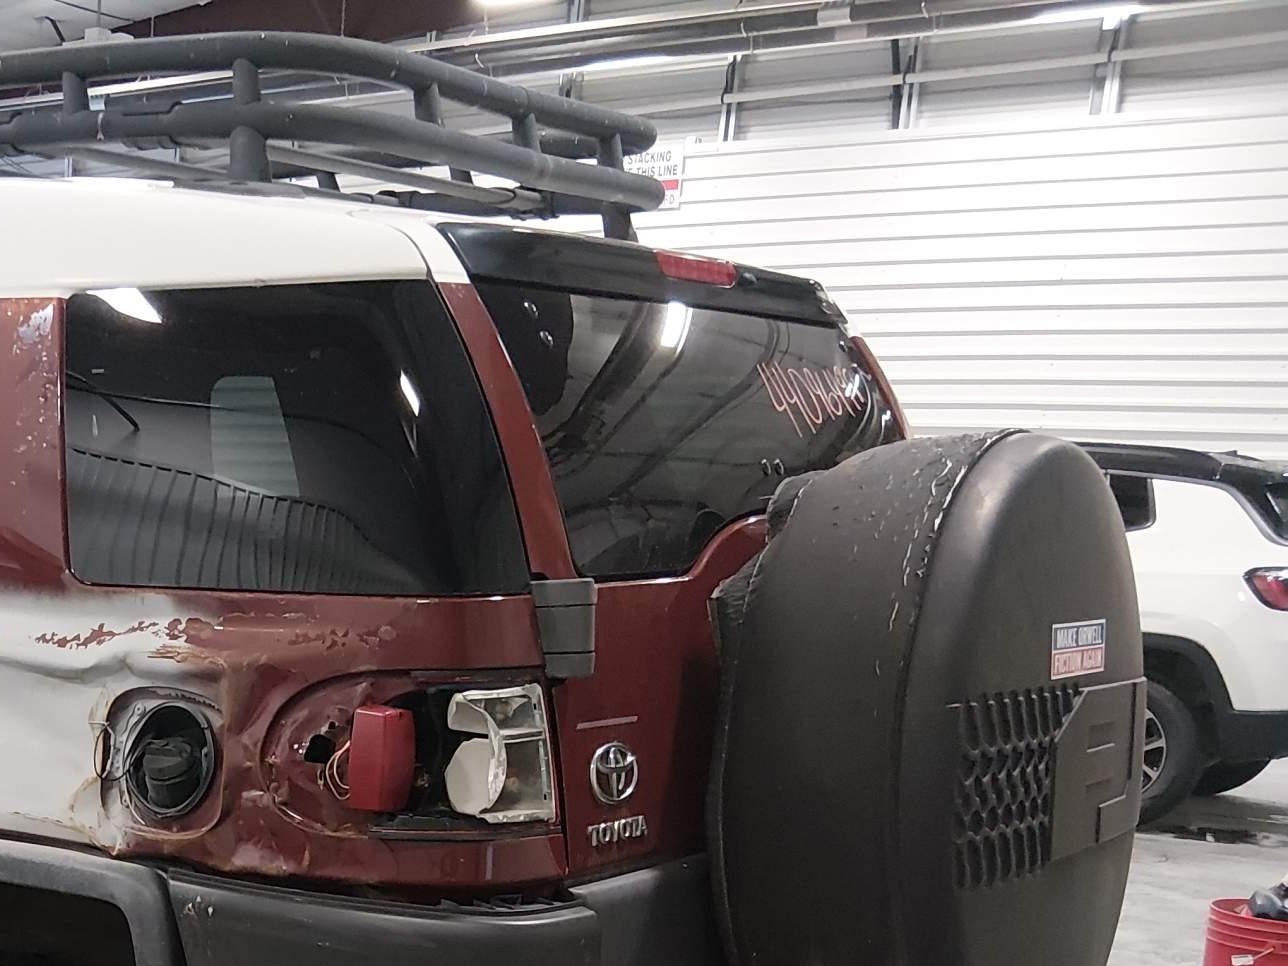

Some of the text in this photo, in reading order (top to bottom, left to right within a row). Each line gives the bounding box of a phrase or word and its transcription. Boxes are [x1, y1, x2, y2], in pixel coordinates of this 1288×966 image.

[627, 150, 672, 165] STACKING
[637, 166, 656, 177] THIS
[658, 164, 678, 177] LINE
[1056, 627, 1078, 649] MAKE
[587, 815, 648, 847] TOYOTA
